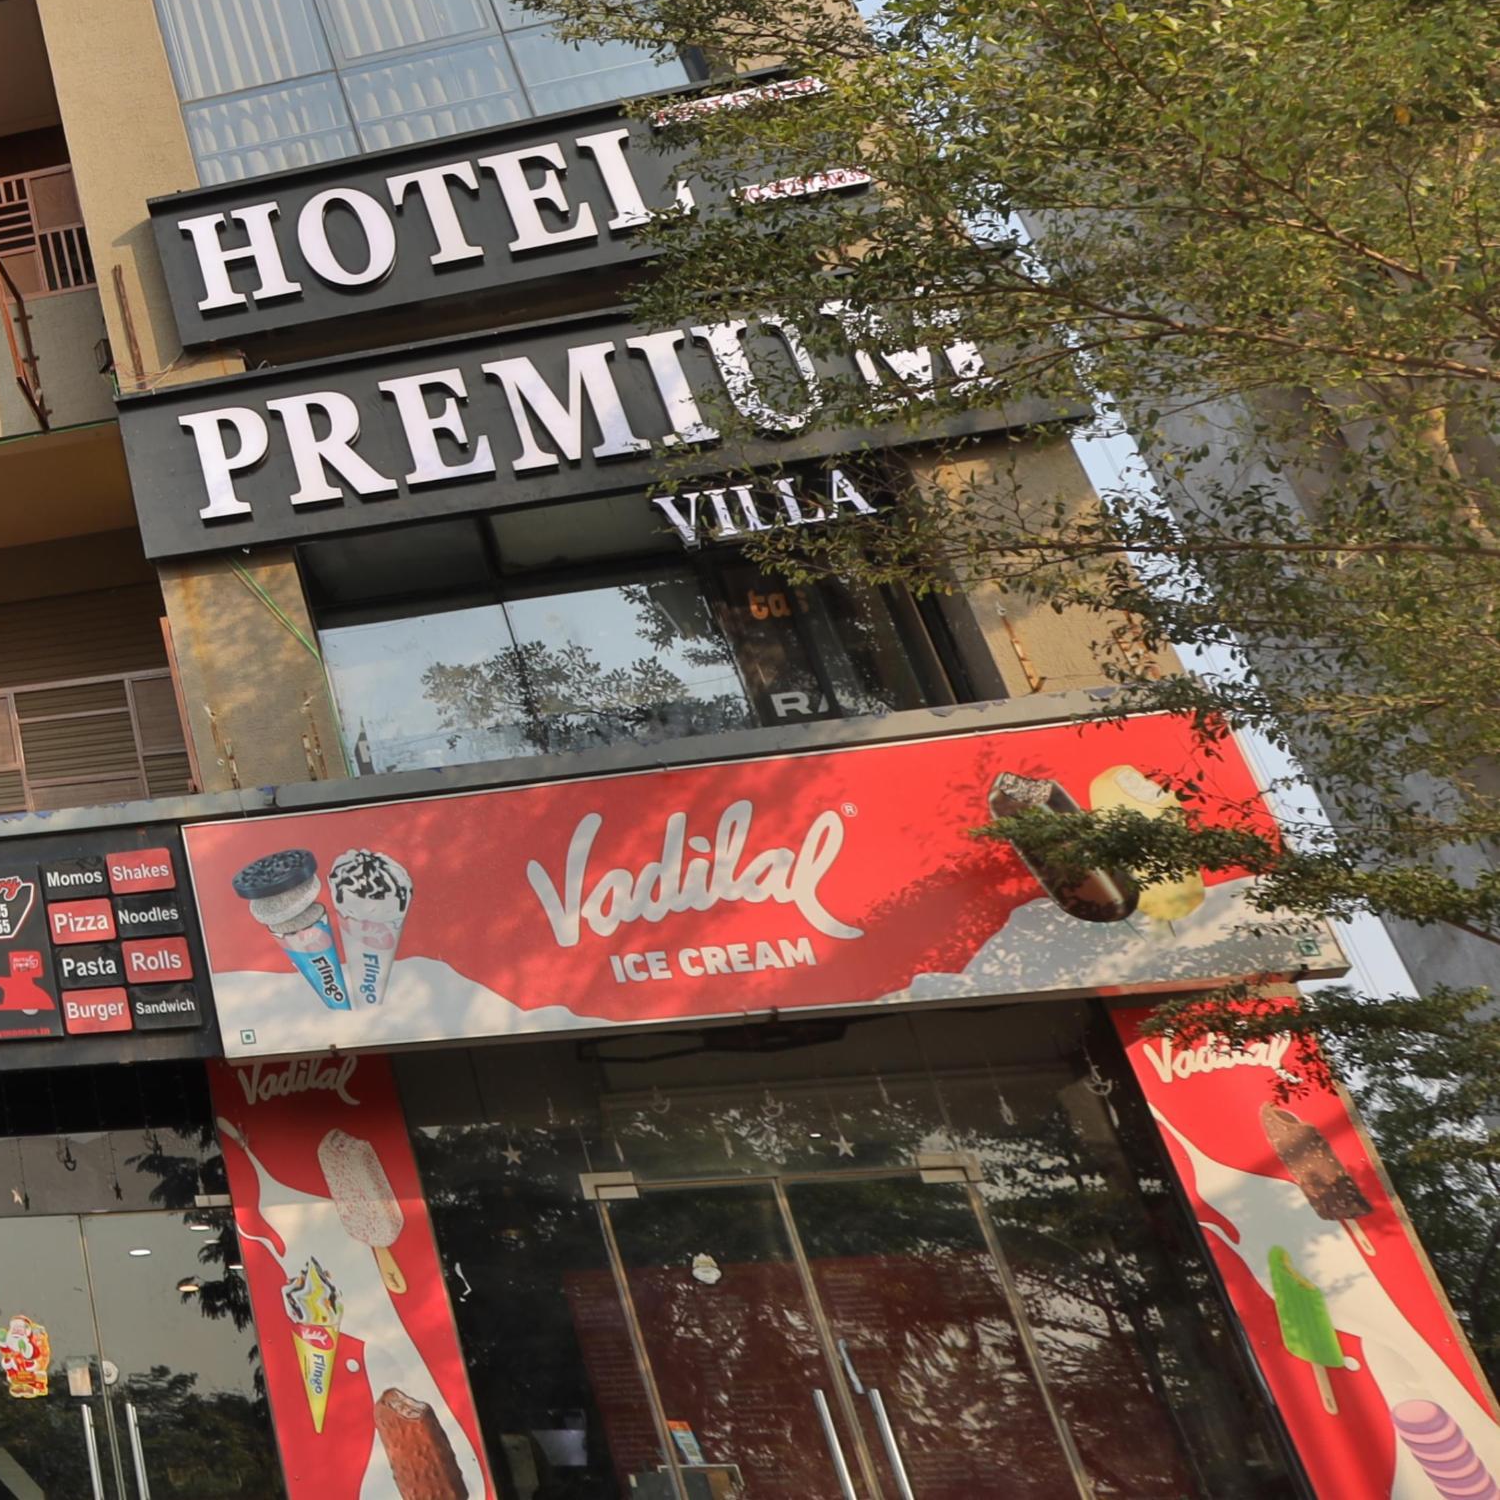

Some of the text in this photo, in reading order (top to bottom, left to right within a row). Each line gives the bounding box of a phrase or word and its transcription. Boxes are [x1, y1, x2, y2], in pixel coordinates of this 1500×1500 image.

[177, 126, 694, 312] HOTEL
[652, 469, 878, 543] VILLA
[46, 870, 103, 887] Momos
[111, 864, 170, 882] Shakes
[527, 798, 864, 948] Vadilal
[53, 913, 109, 934] Pizza
[118, 906, 179, 925] Noodles
[61, 956, 118, 977] Pasta
[130, 950, 183, 972] Rolls
[612, 936, 819, 984] ICE CREAM
[311, 955, 345, 1003] Flingo
[359, 952, 382, 1005] Flingo
[66, 1001, 124, 1021] Burger
[135, 998, 196, 1015] Sandwich
[237, 1055, 361, 1105] Vadilal
